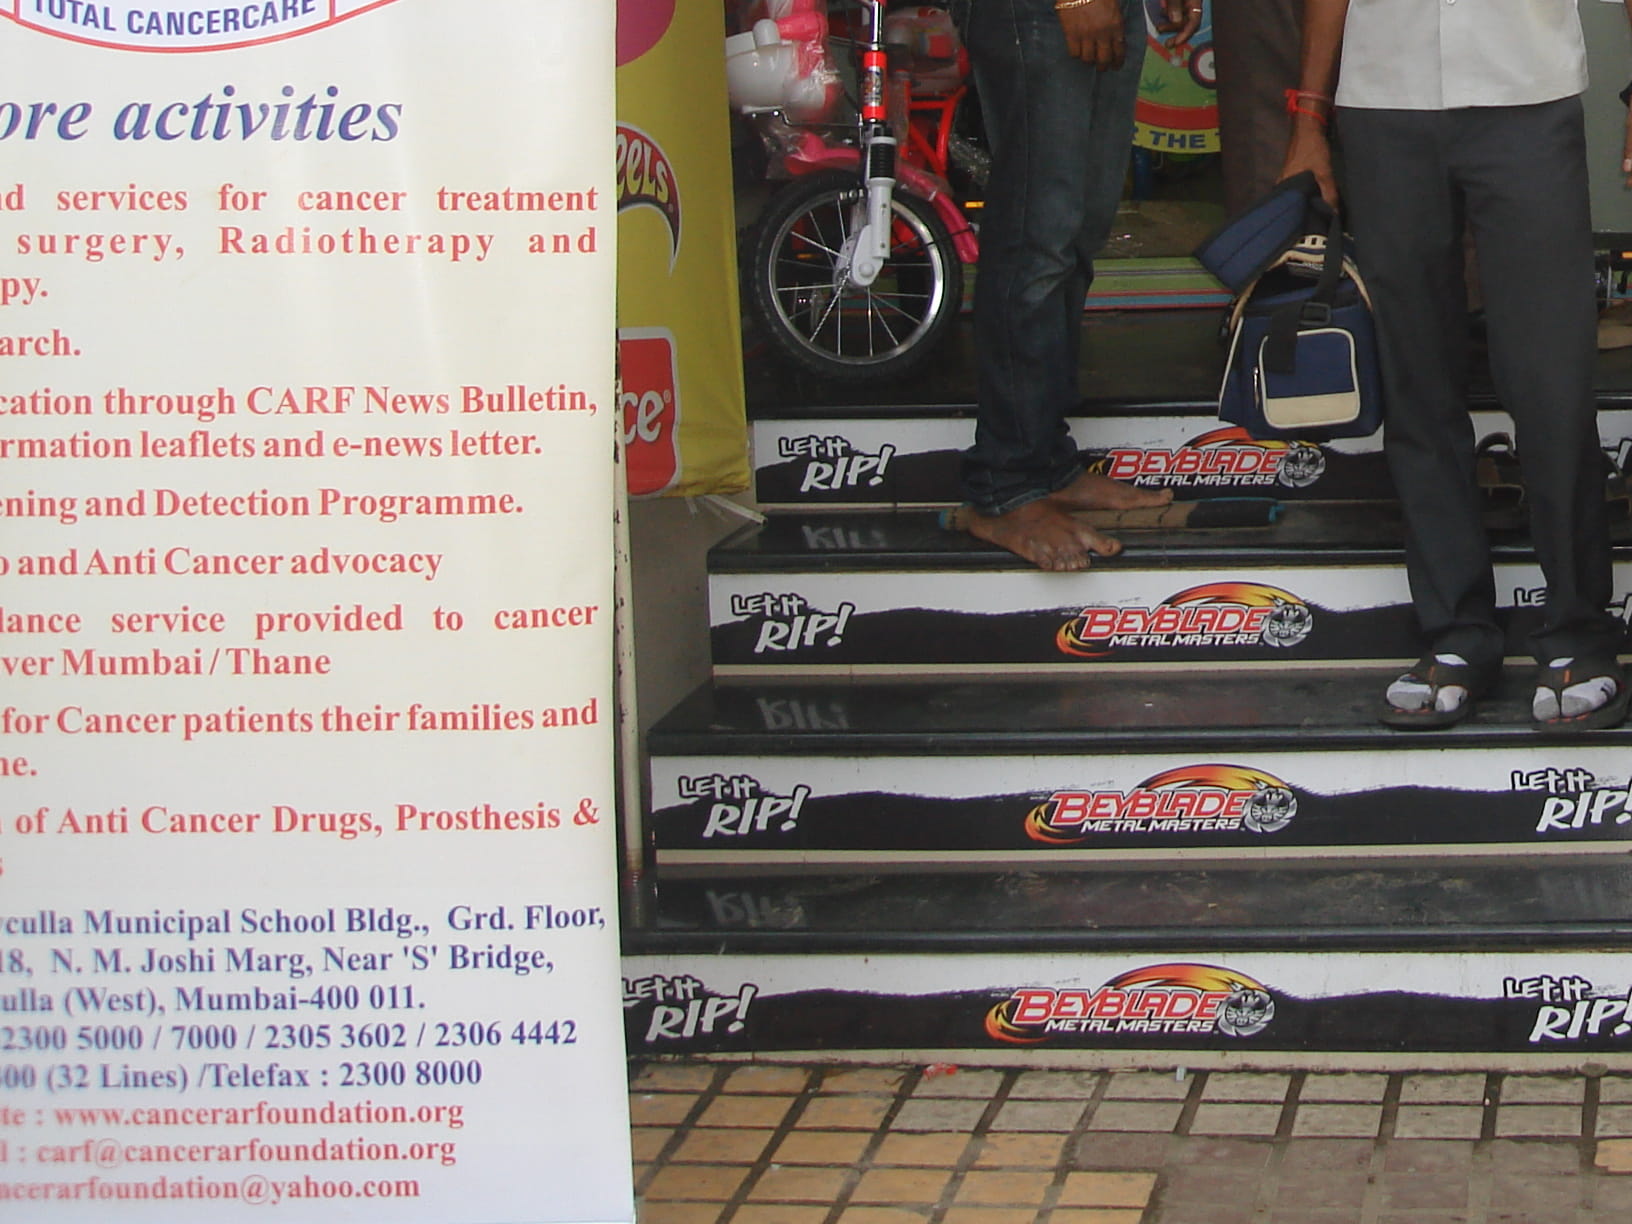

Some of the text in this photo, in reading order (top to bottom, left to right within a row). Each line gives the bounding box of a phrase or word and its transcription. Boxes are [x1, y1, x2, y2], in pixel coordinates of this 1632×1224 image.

[113, 85, 402, 141] activities
[57, 184, 598, 211] services for cancer treatment
[17, 227, 596, 262] surgery, Radiotherapy and
[103, 384, 596, 422] through CARF News Bulletin,
[140, 430, 541, 458] leaflets and e-news letter.
[779, 436, 823, 457] LET
[801, 445, 896, 493] RIP!
[1107, 446, 1287, 479] BEYBLADE
[1133, 473, 1278, 487] METAL MASTERS
[85, 489, 523, 523] and Detection Programme.
[84, 547, 442, 581] Anti Cancer advocacy
[731, 594, 807, 616] LET IT
[754, 603, 854, 653] RIP!
[1080, 604, 1270, 641] BEYBLADE
[1108, 631, 1263, 647] METAL MASTERS
[62, 648, 330, 675] Mumbai Thane
[677, 775, 759, 798] LET IT
[1510, 769, 1594, 792] LET IT
[273, 802, 560, 840] Drugs, Prosthesis
[702, 785, 810, 838] RIP!
[1048, 790, 1254, 826] BEYBLADE
[1080, 818, 1244, 833] METAL MASTERS
[84, 908, 429, 941] Municipal School Bldg.,
[1502, 976, 1593, 1001] LET IT
[645, 984, 758, 1041] RIP!
[1010, 988, 1222, 1028] BEYBLADE
[1043, 1019, 1214, 1035] METAL MASTERS
[56, 1100, 464, 1129] www.cancerarfoundation.org
